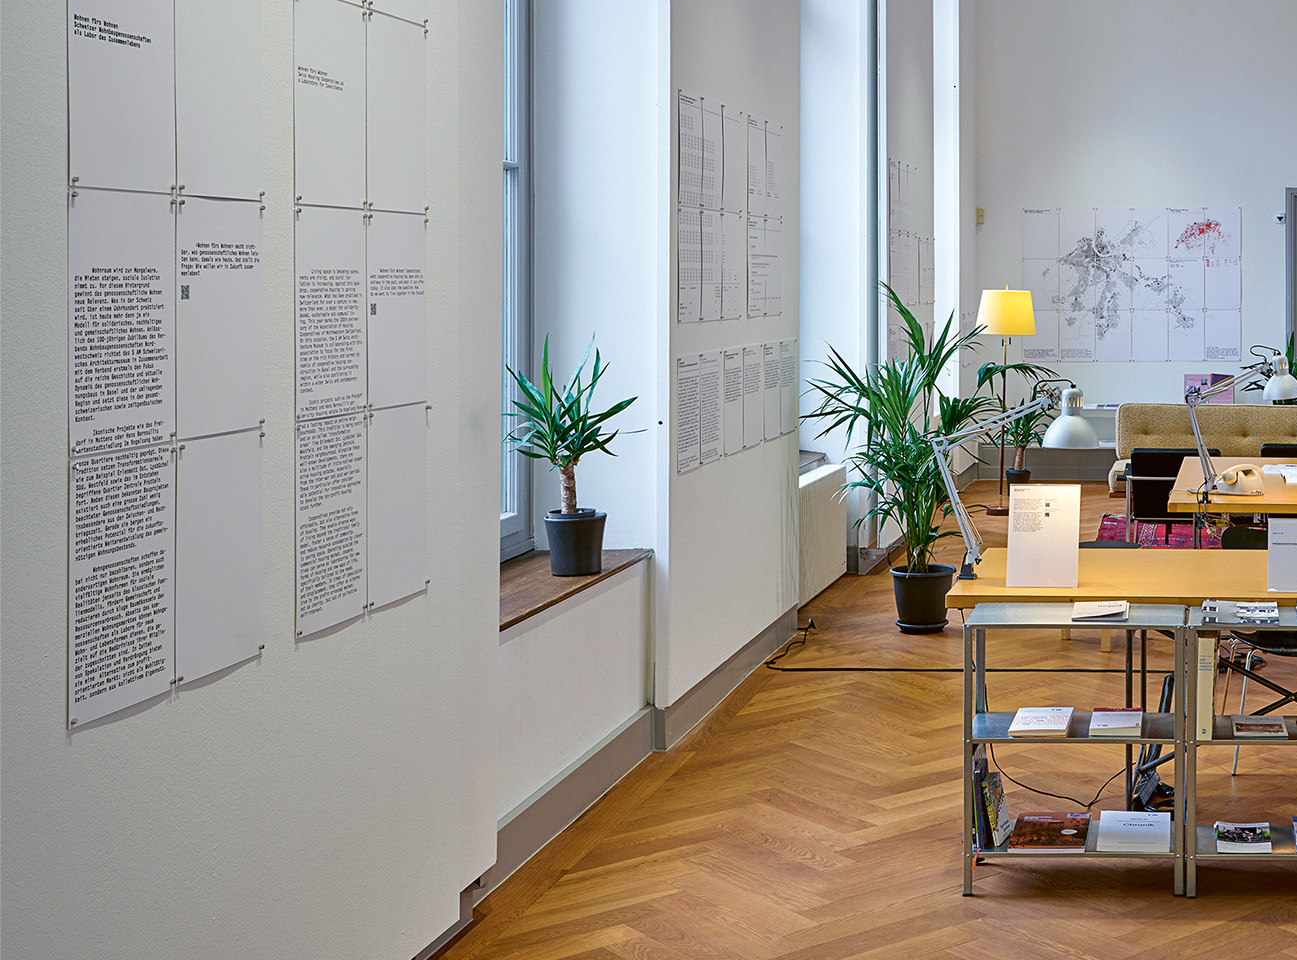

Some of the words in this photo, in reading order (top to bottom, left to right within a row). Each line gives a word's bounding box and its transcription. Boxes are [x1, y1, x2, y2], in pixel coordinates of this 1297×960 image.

[73, 21, 96, 32] Schweizer
[74, 13, 89, 23] Wohnen
[91, 17, 101, 25] fürs
[103, 20, 118, 29] Wohnen
[83, 30, 96, 39] Labor
